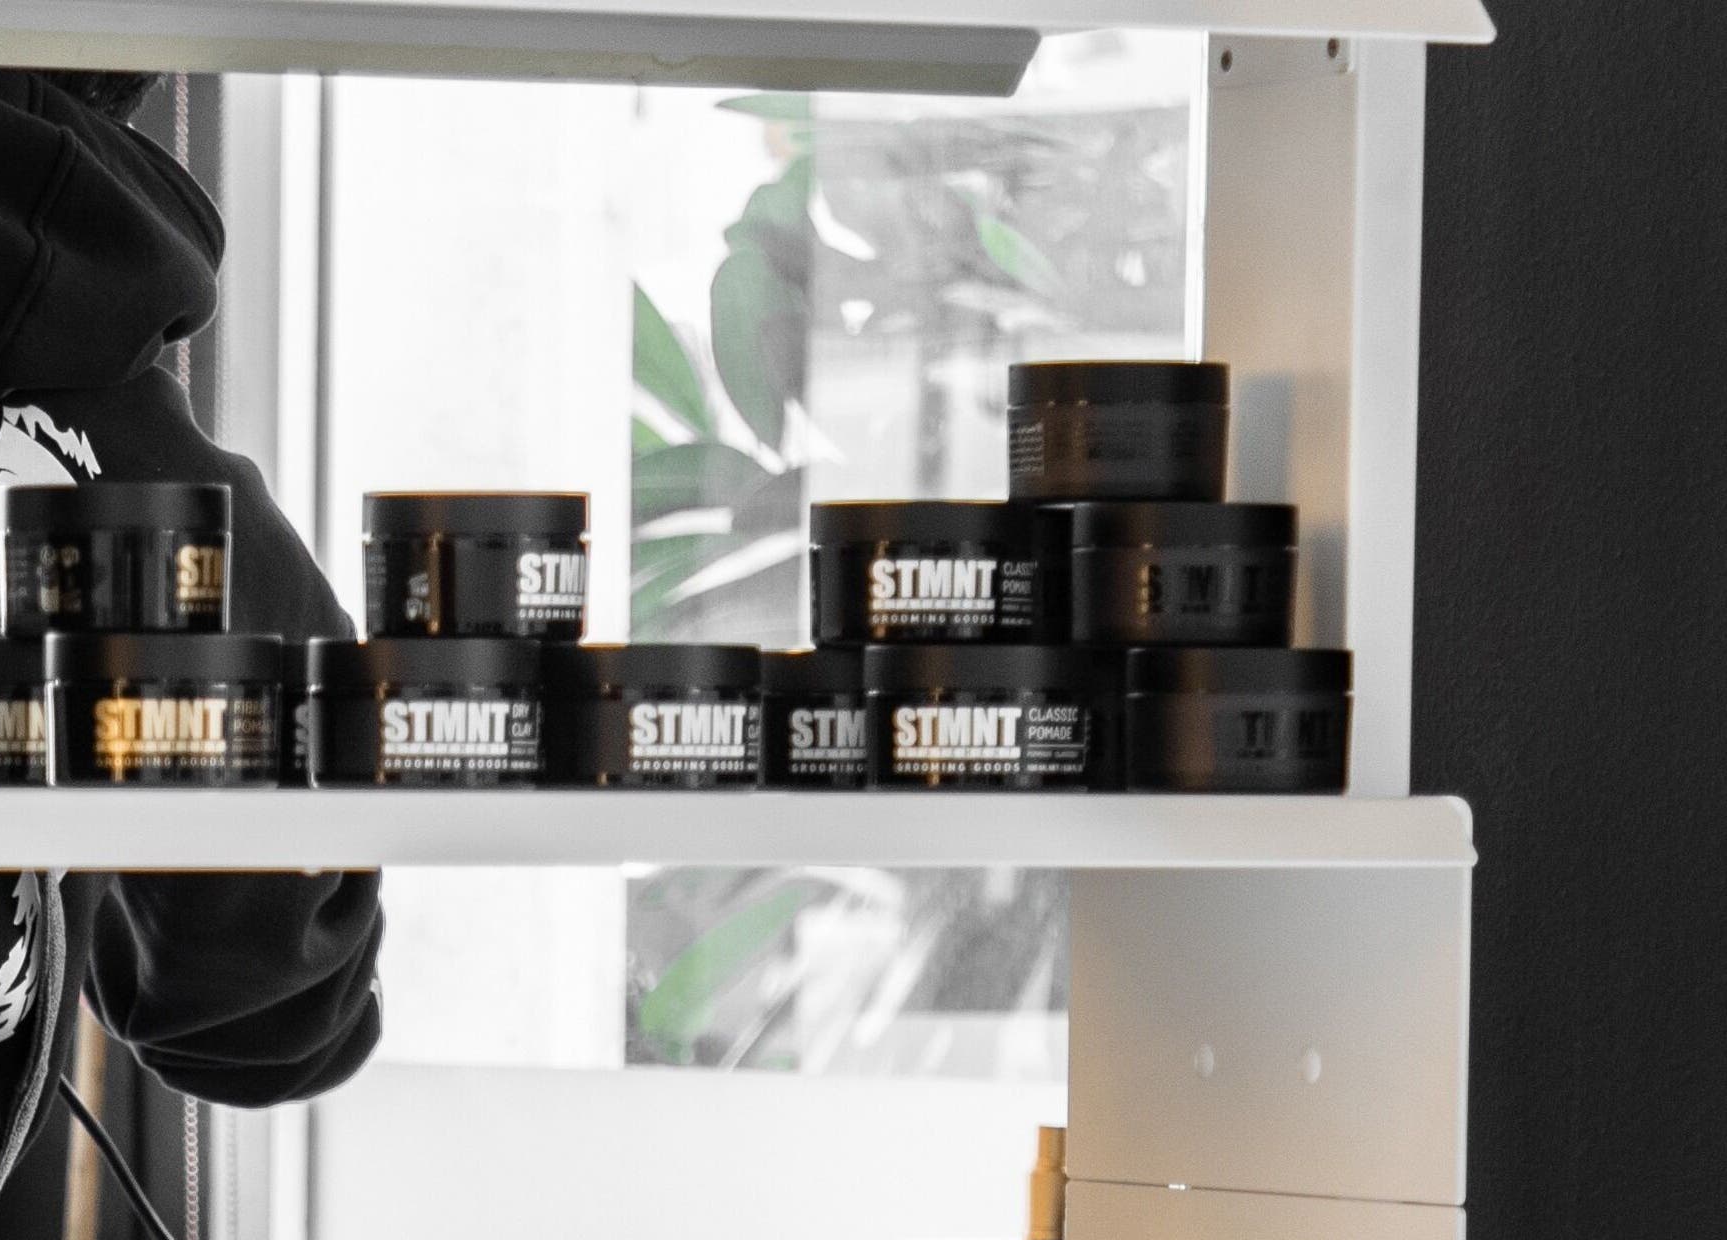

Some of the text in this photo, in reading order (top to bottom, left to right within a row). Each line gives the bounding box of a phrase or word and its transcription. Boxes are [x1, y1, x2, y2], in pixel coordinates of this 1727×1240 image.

[872, 559, 997, 598] STMNT
[95, 698, 227, 741] STMNT
[384, 701, 509, 742] STMNT
[632, 703, 747, 745] STMNT
[895, 707, 1022, 747] STMNT
[1028, 707, 1078, 722] CLASSIC
[1028, 726, 1072, 740] POMADE
[384, 758, 461, 769] GROOMING
[632, 760, 707, 771] GROOMING
[896, 762, 1021, 772] GROOMING GOODS
